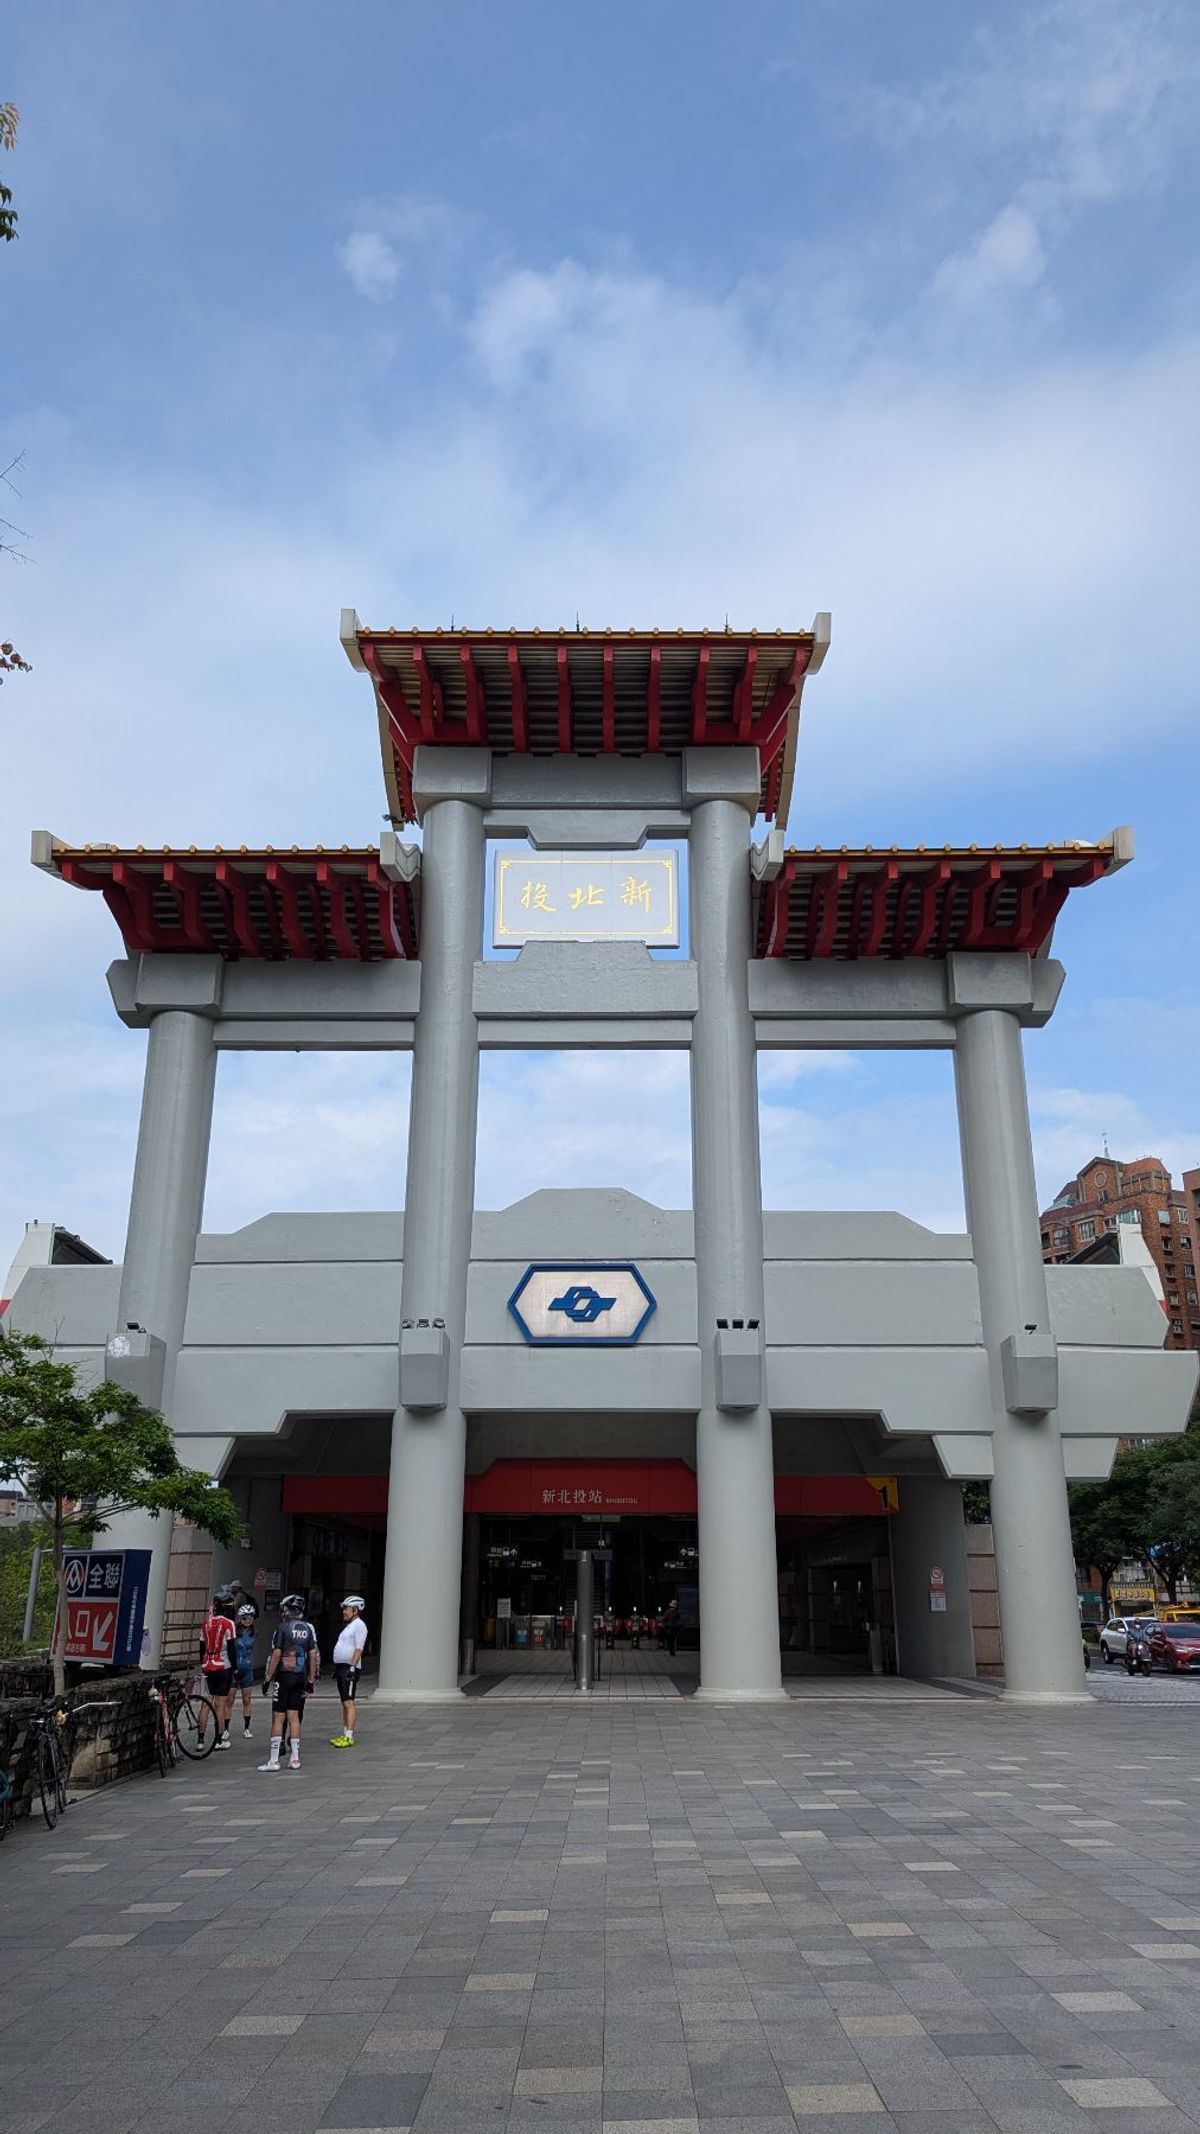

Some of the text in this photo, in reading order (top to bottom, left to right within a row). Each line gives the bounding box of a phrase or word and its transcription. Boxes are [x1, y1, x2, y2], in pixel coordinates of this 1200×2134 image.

[520, 876, 652, 913] 新北投
[542, 1489, 602, 1504] 新北投站
[878, 1485, 889, 1510] 1
[88, 1563, 120, 1589] 全聯
[292, 1630, 308, 1639] TKO
